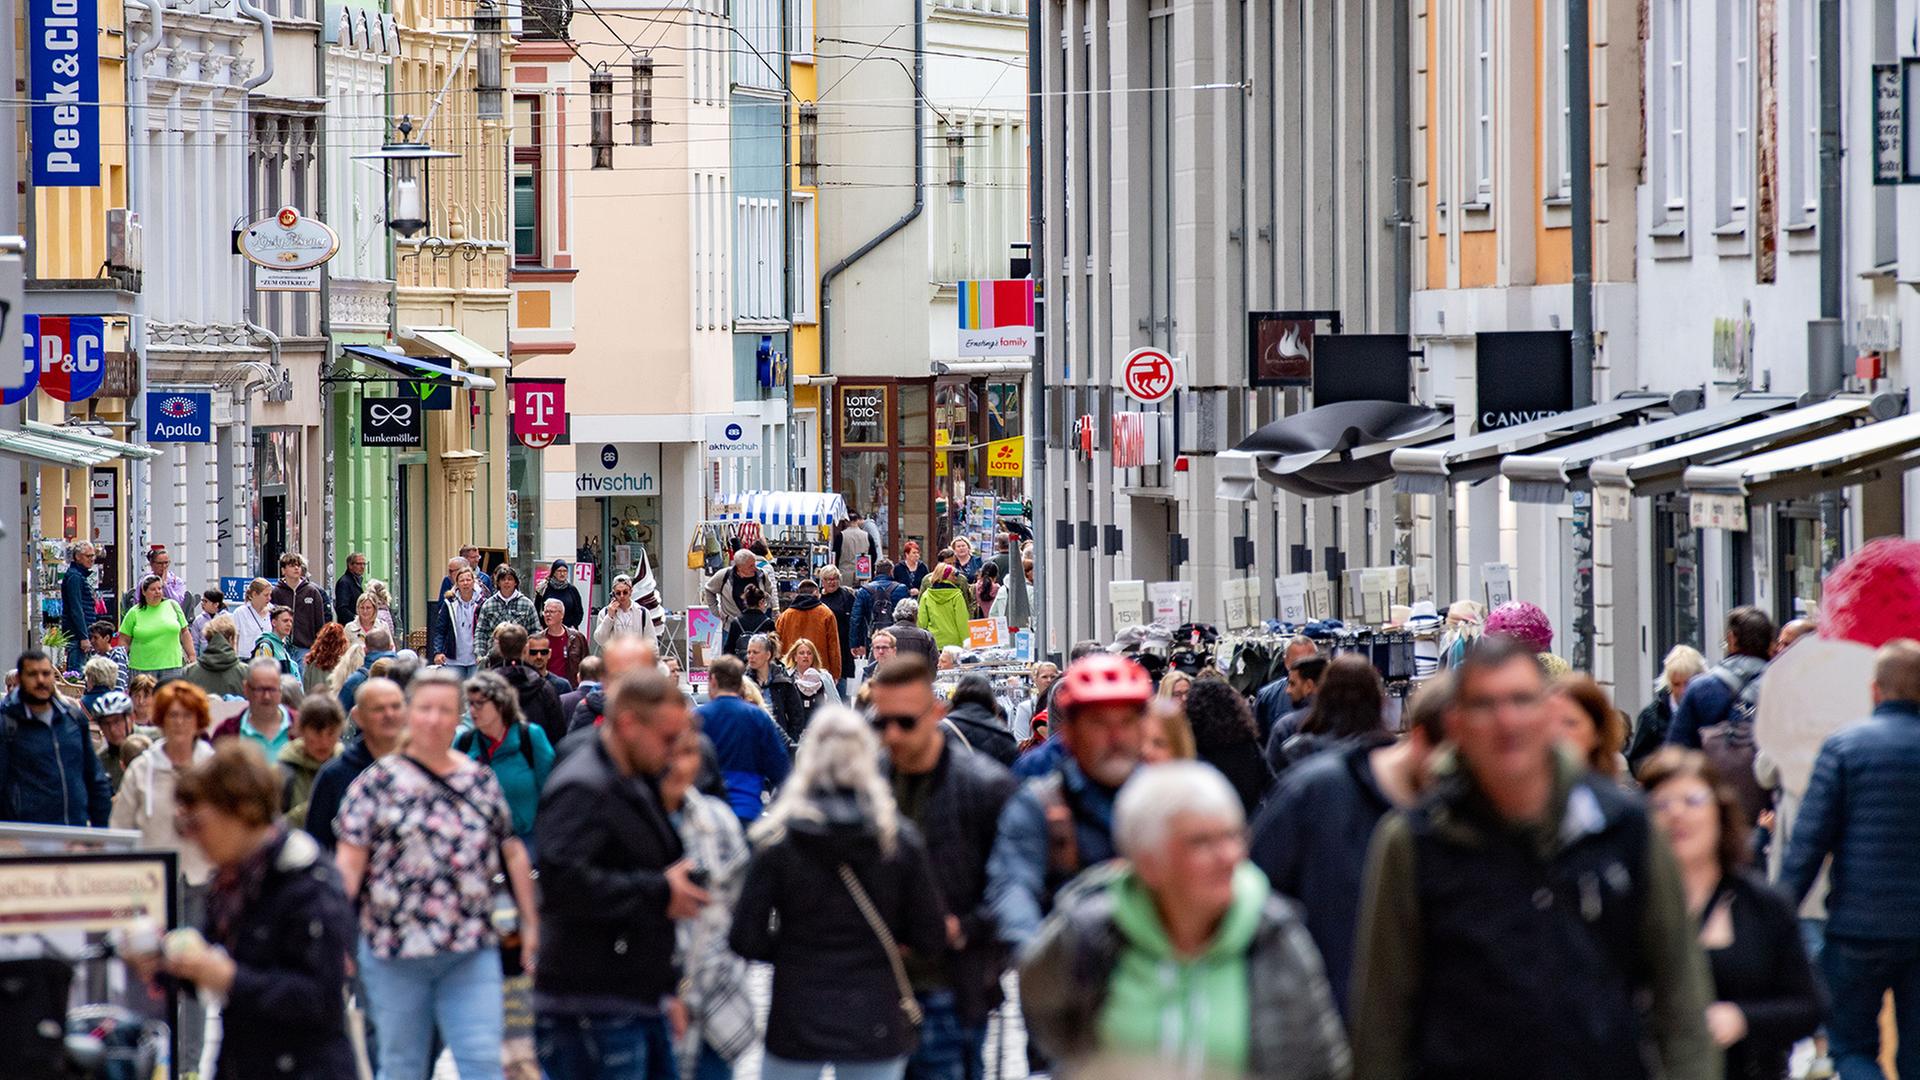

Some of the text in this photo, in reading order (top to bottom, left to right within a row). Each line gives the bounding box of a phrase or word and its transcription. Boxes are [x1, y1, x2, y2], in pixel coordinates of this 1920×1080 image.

[1000, 336, 1028, 348] family
[41, 334, 99, 373] P&C
[526, 391, 554, 426] T
[1483, 410, 1566, 427] CANVE
[154, 422, 201, 439] Apollo
[363, 432, 419, 443] hunkemöller
[709, 442, 759, 451] aktivschuh
[991, 460, 1019, 470] LOTTO
[987, 620, 995, 631] 3
[985, 631, 993, 642] 2
